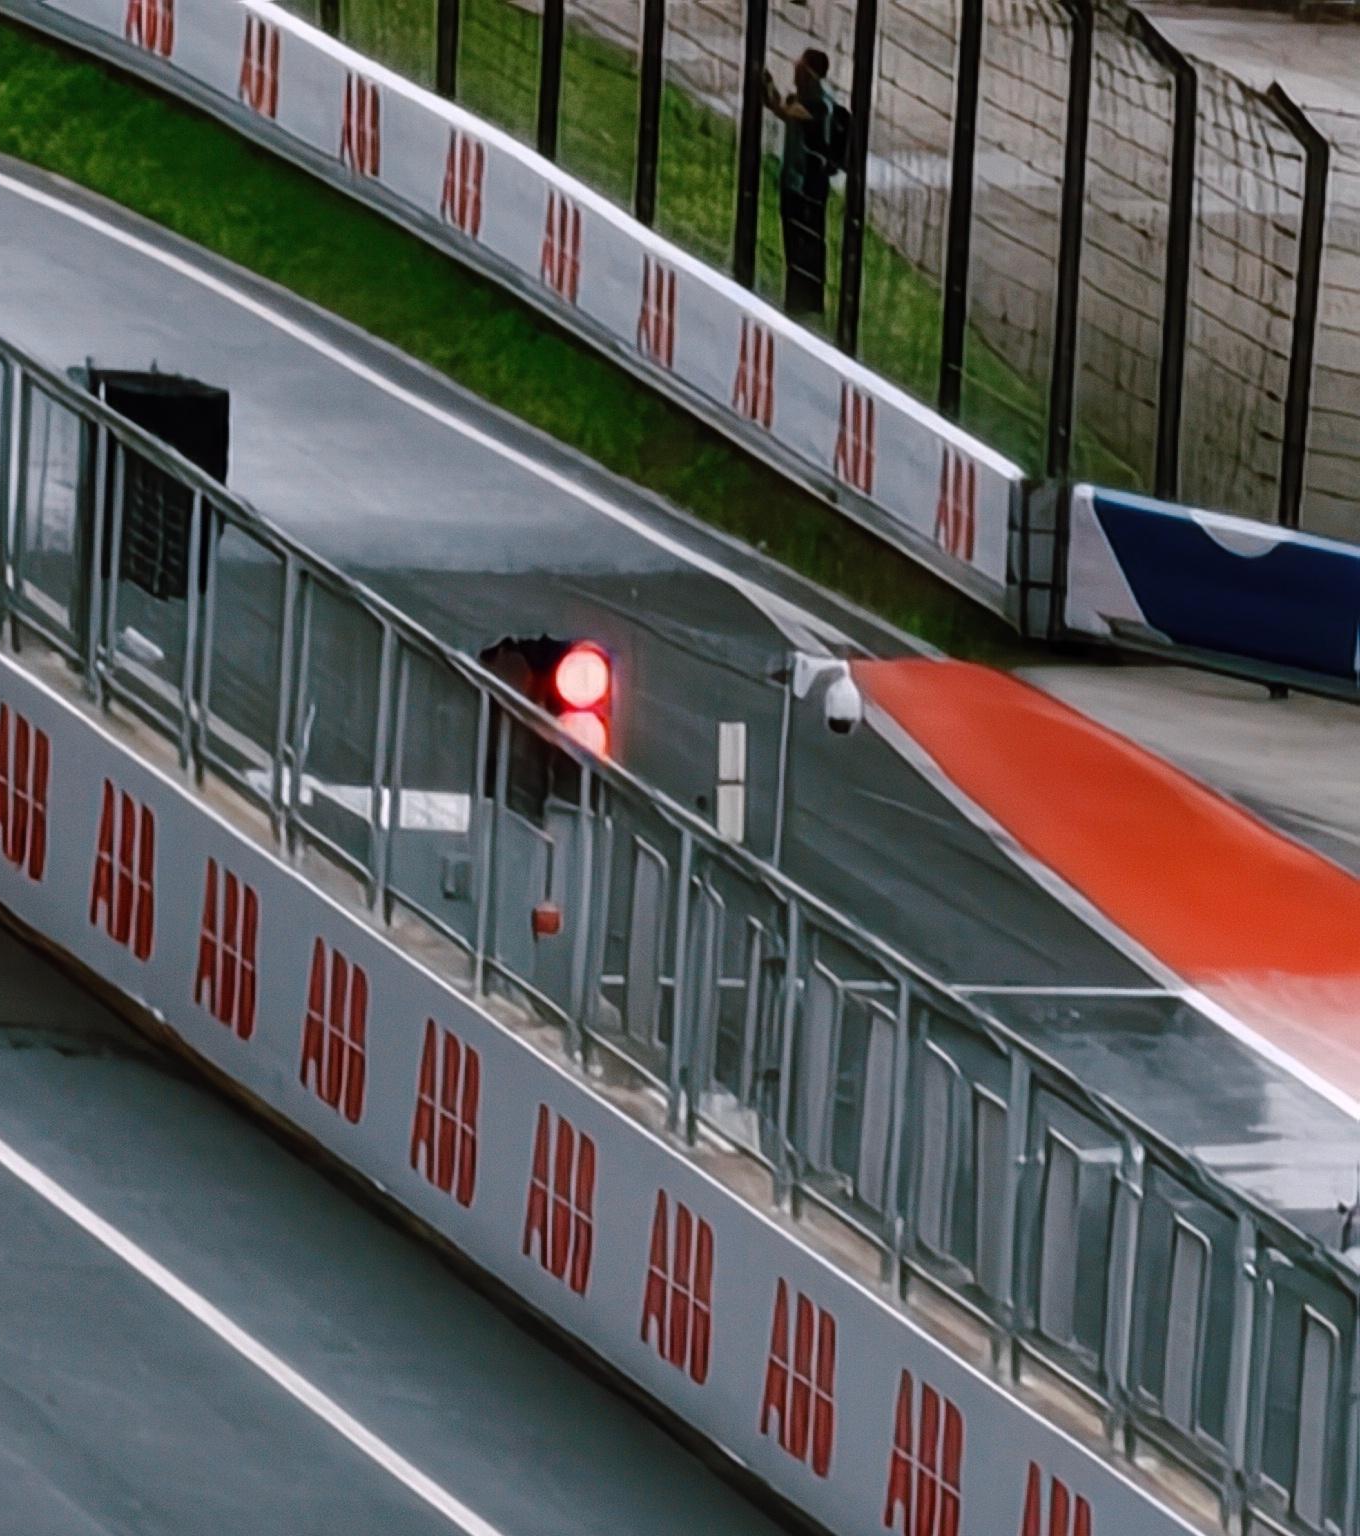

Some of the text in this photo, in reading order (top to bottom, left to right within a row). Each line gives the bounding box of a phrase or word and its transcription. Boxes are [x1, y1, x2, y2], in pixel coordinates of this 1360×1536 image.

[90, 777, 155, 962] ABB
[194, 856, 258, 1041] ABB
[300, 936, 368, 1124] ABB
[410, 1018, 481, 1208] ABB
[522, 1103, 597, 1298] ABB
[640, 1188, 714, 1386] ABB
[760, 1276, 836, 1478] ABB
